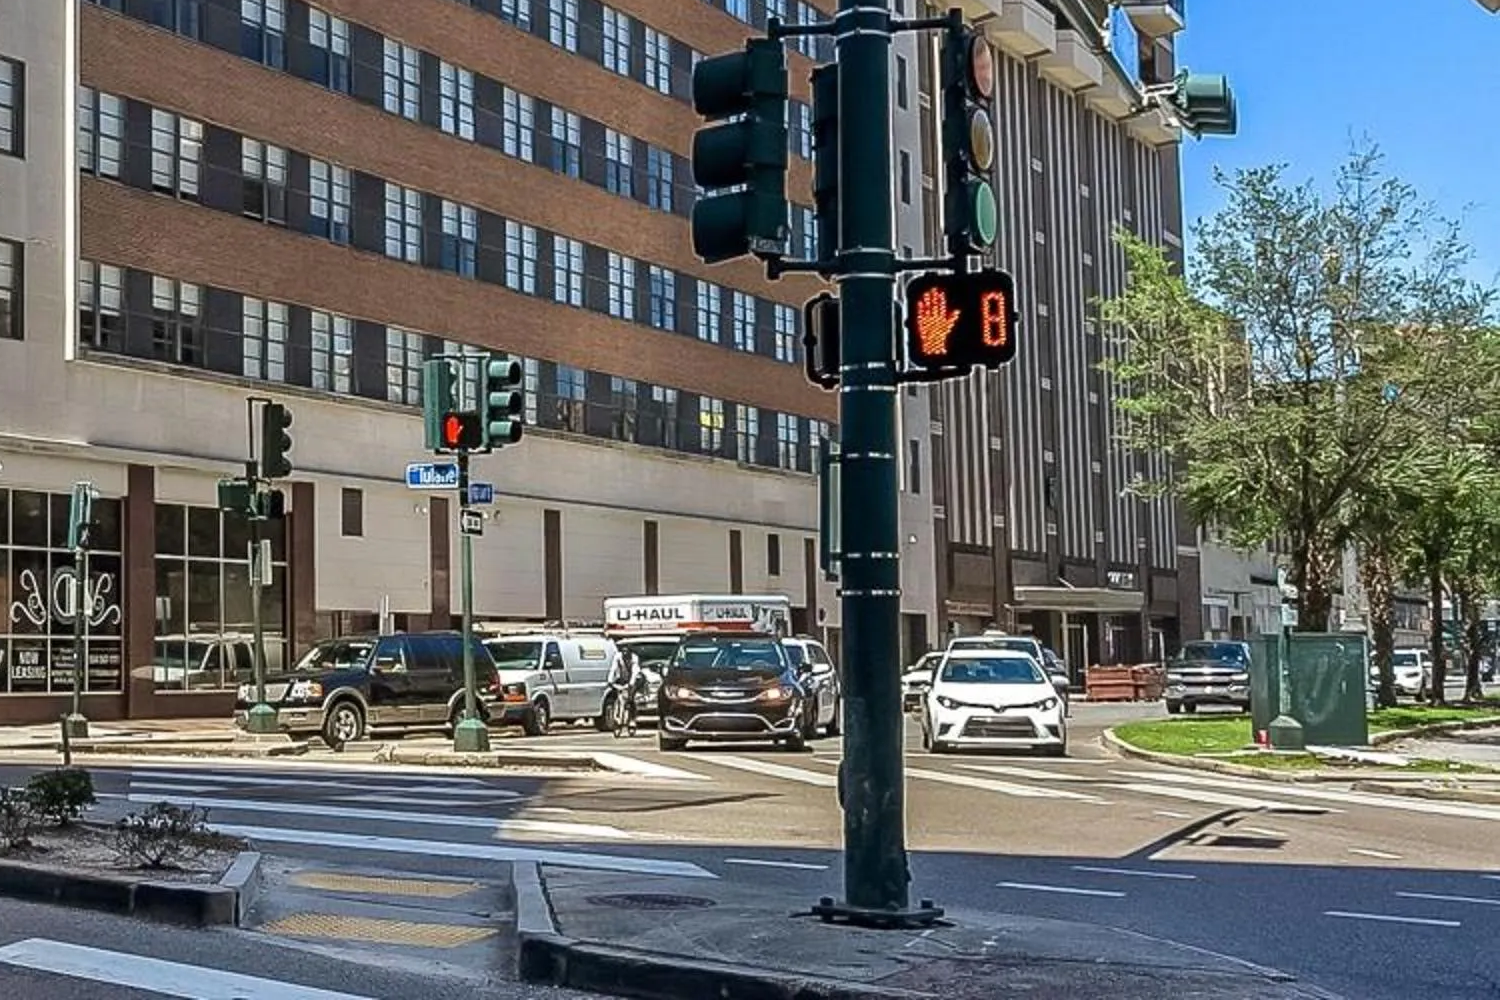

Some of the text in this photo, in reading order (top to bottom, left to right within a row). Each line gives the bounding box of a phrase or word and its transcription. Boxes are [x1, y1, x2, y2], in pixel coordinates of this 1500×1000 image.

[982, 291, 1007, 346] 8
[617, 607, 685, 621] U-HAUL
[19, 651, 40, 665] NOW
[11, 665, 46, 679] LEASING
